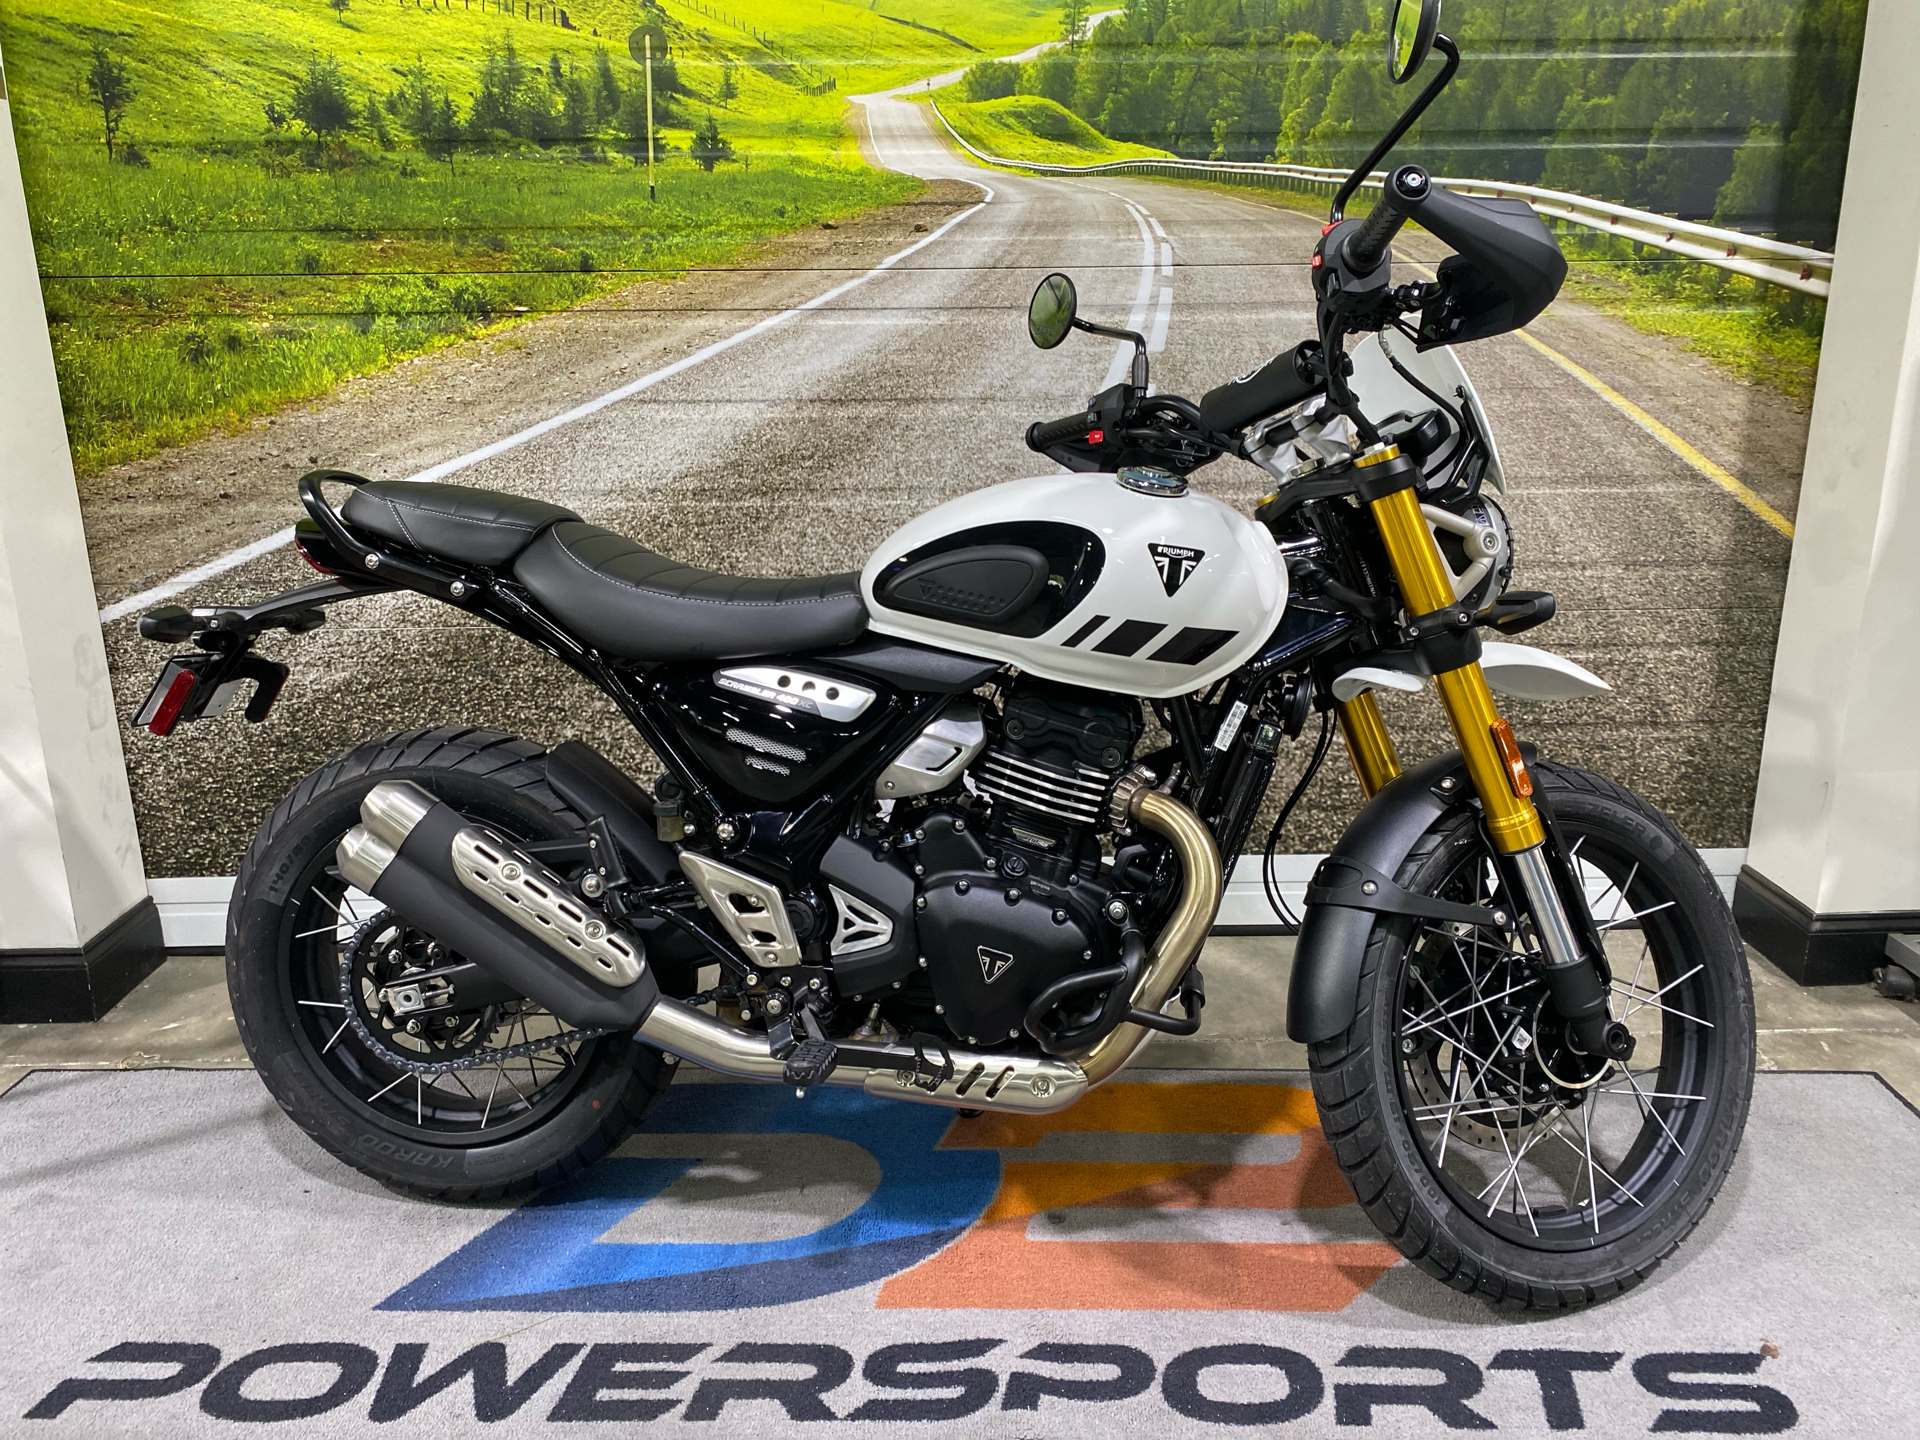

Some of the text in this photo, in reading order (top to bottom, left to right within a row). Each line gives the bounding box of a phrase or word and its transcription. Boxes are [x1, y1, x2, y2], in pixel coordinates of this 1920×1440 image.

[1157, 546, 1195, 558] TRIUMPH
[717, 678, 776, 699] SCRAMBLER
[776, 694, 799, 705] 400
[357, 1133, 454, 1169] KAROO
[22, 1338, 1799, 1434] POWERSPORTS
